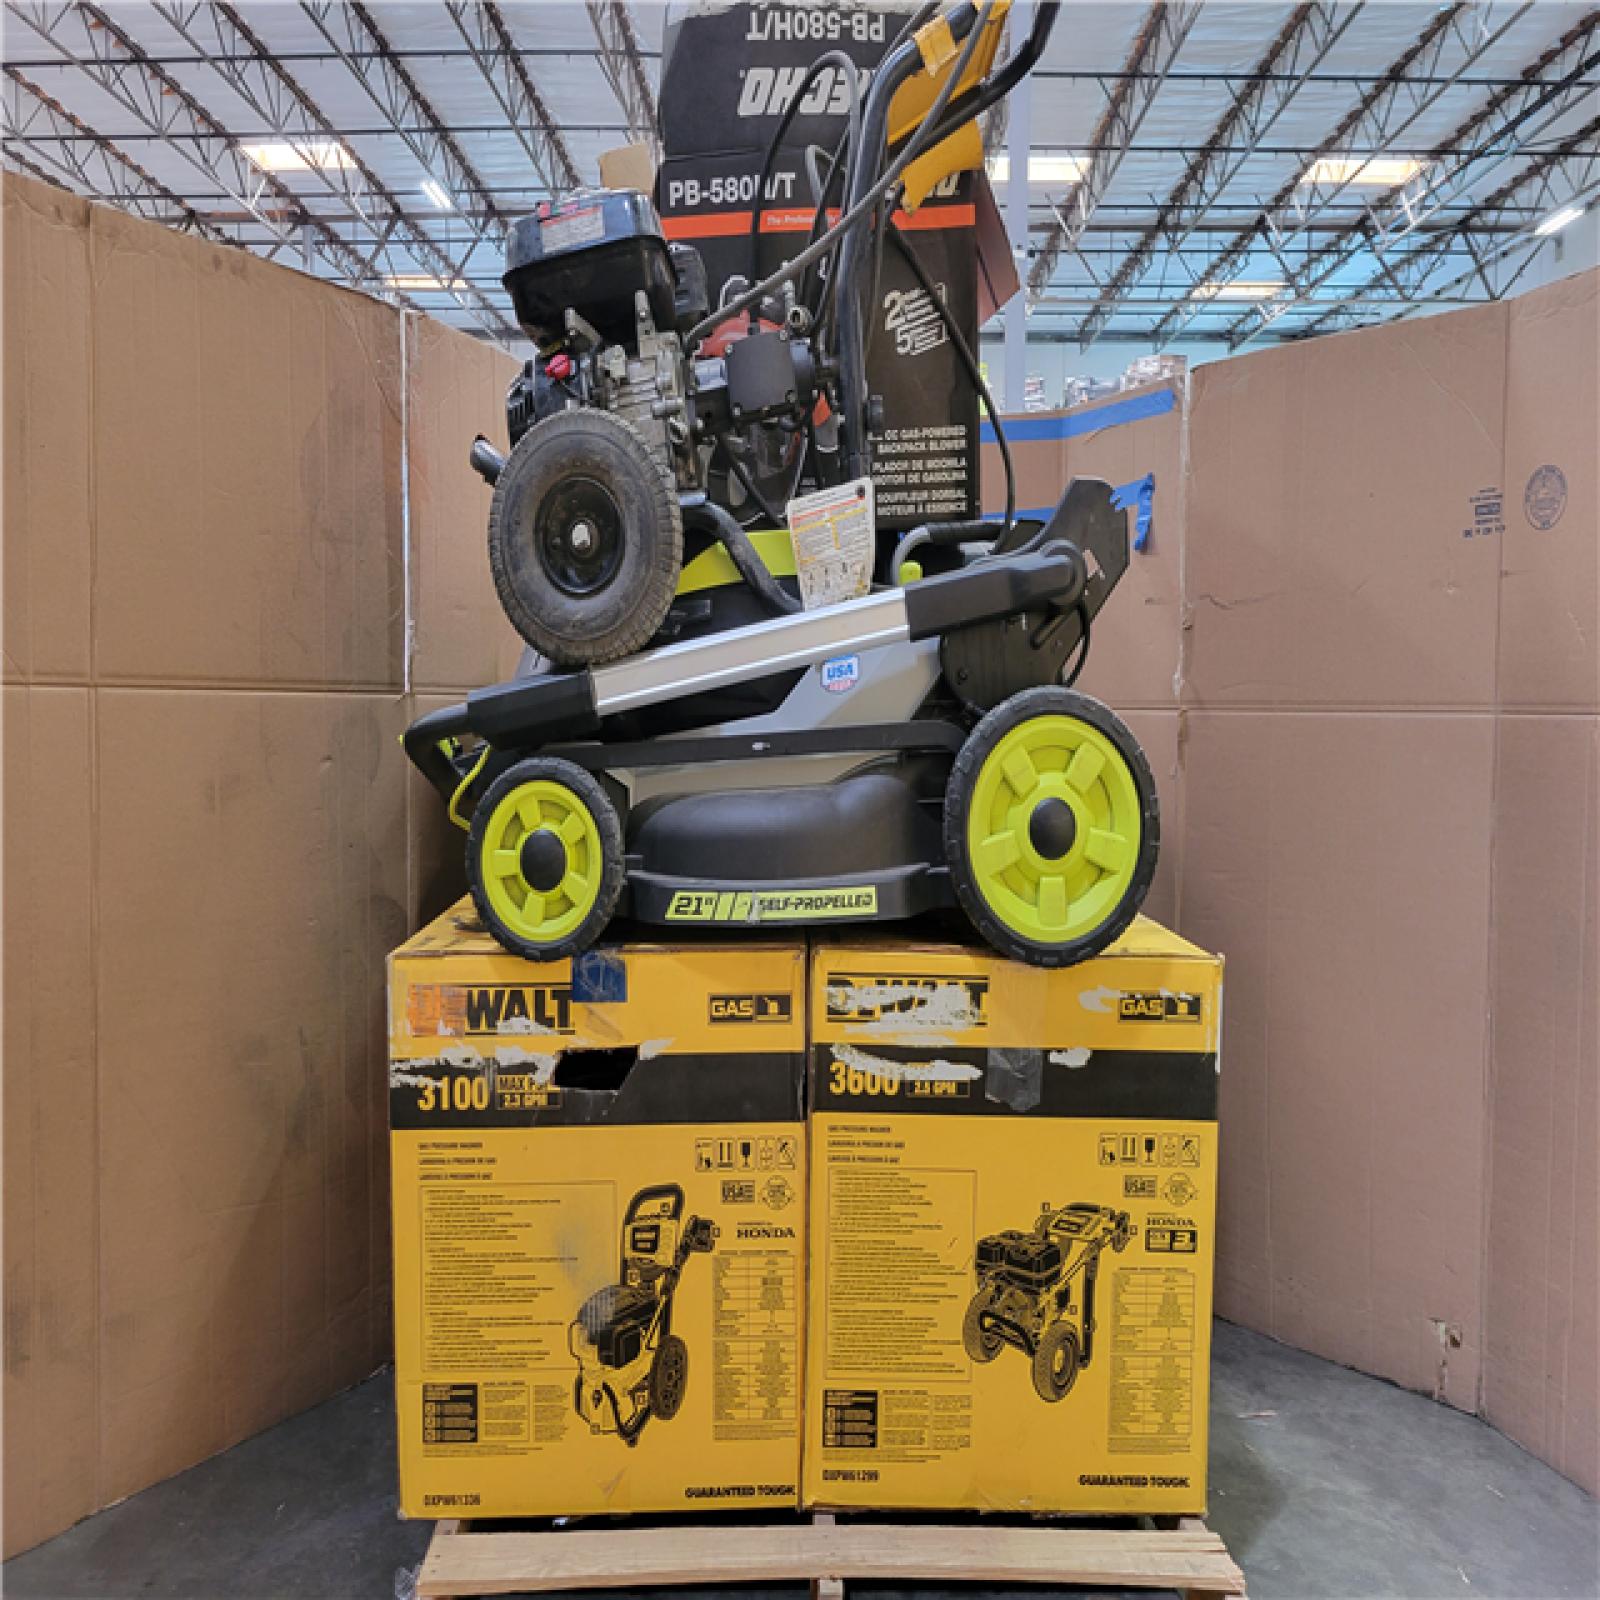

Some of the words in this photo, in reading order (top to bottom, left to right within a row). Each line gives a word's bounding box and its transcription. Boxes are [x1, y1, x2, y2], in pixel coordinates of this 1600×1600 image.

[745, 10, 886, 42] PB-580H/T
[737, 67, 876, 116] ECHO
[826, 662, 854, 680] USA
[674, 896, 714, 916] 21"
[759, 893, 874, 911] SELF-PROPELLED
[711, 1000, 753, 1016] GAS
[1121, 1000, 1163, 1016] GAS
[417, 1076, 489, 1111] 3100
[1146, 1217, 1197, 1228] HONDA
[736, 1226, 796, 1239] HONDA
[1079, 1474, 1148, 1488] GUARANTEED
[684, 1485, 755, 1498] GUARANTEED
